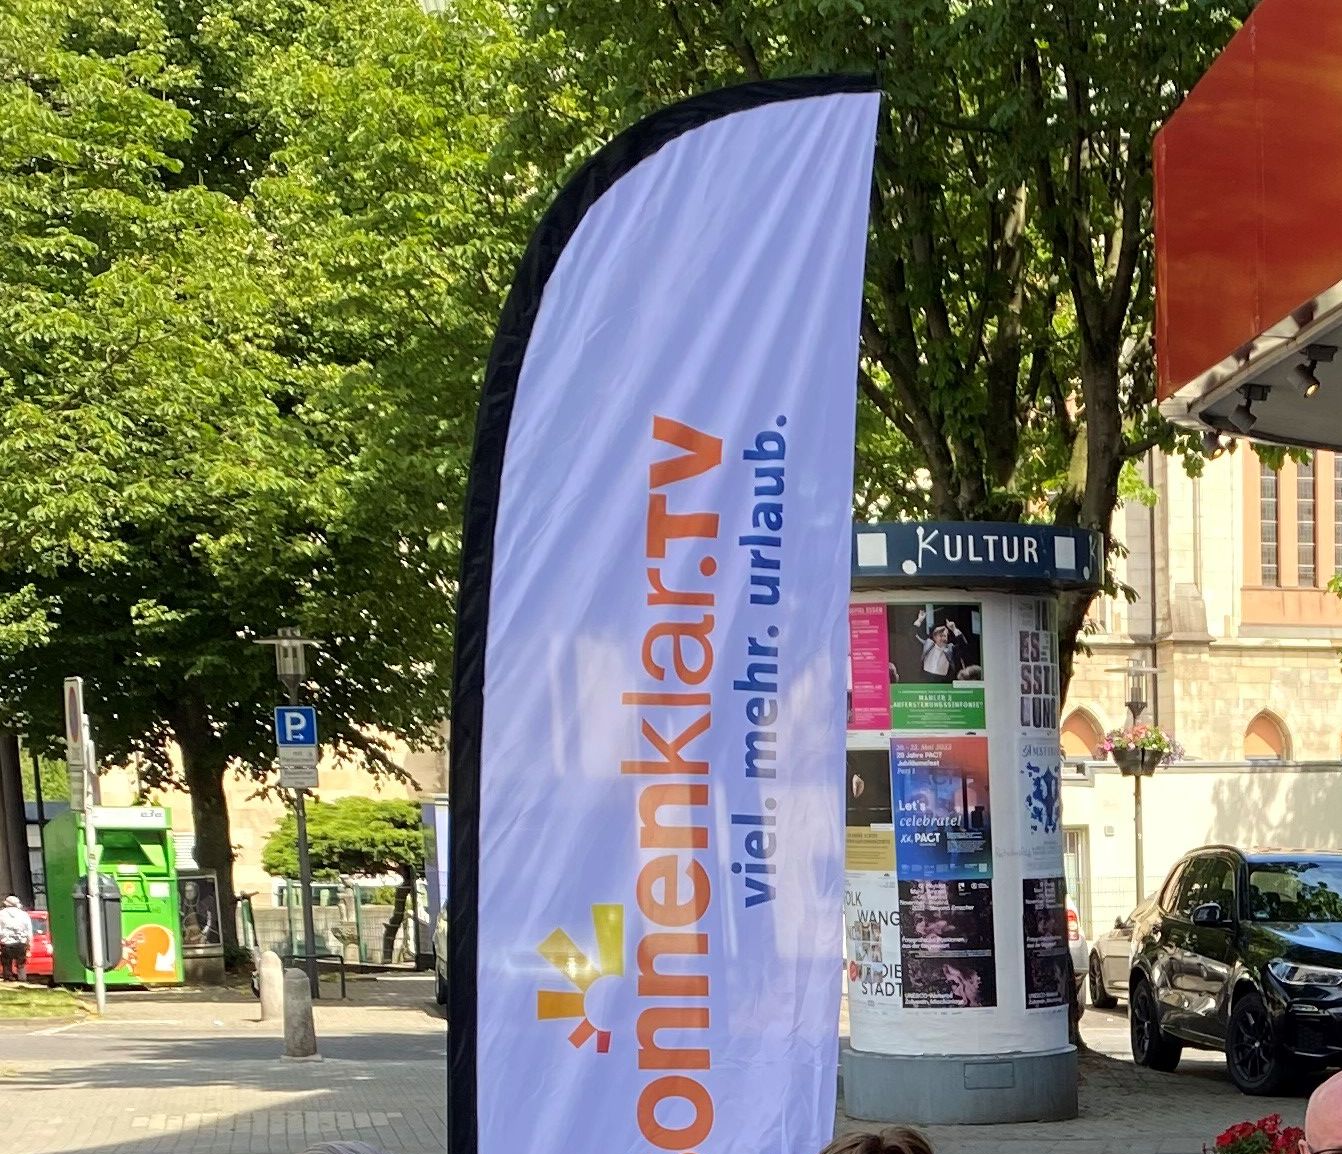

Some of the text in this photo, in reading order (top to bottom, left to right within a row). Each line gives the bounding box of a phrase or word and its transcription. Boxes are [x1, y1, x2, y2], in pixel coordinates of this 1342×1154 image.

[915, 525, 1039, 569] KULTUR
[731, 413, 788, 910] viel. mehr. urlaub.
[284, 712, 307, 741] P
[899, 800, 926, 811] Let's
[900, 816, 962, 827] celebrate!
[915, 832, 941, 843] PACT
[845, 890, 863, 907] OLK
[857, 910, 901, 927] WANG
